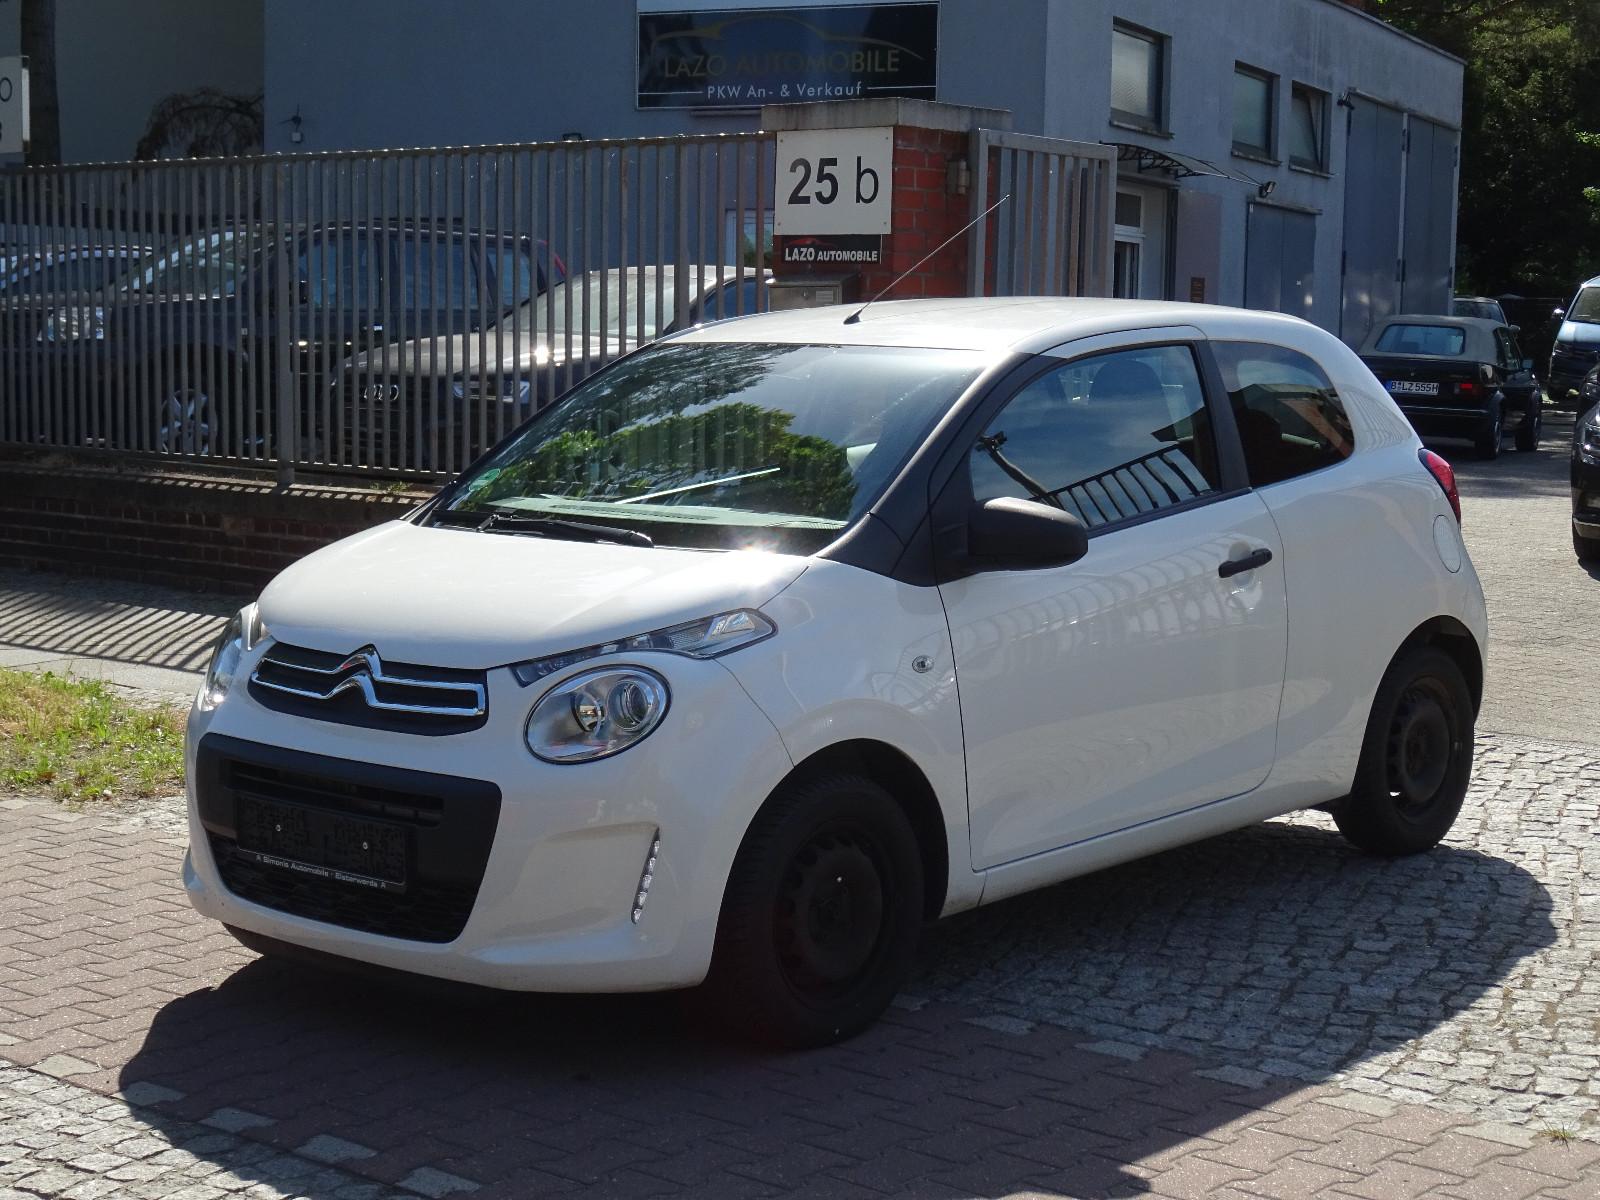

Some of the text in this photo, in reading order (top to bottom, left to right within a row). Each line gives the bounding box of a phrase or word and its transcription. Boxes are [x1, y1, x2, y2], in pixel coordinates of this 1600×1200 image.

[664, 49, 901, 78] LAZO AUTOMOBILE
[707, 81, 863, 99] PKW An- & Verkauf
[787, 155, 880, 205] 25 b
[784, 247, 879, 262] LAZO AUTOMOBILE
